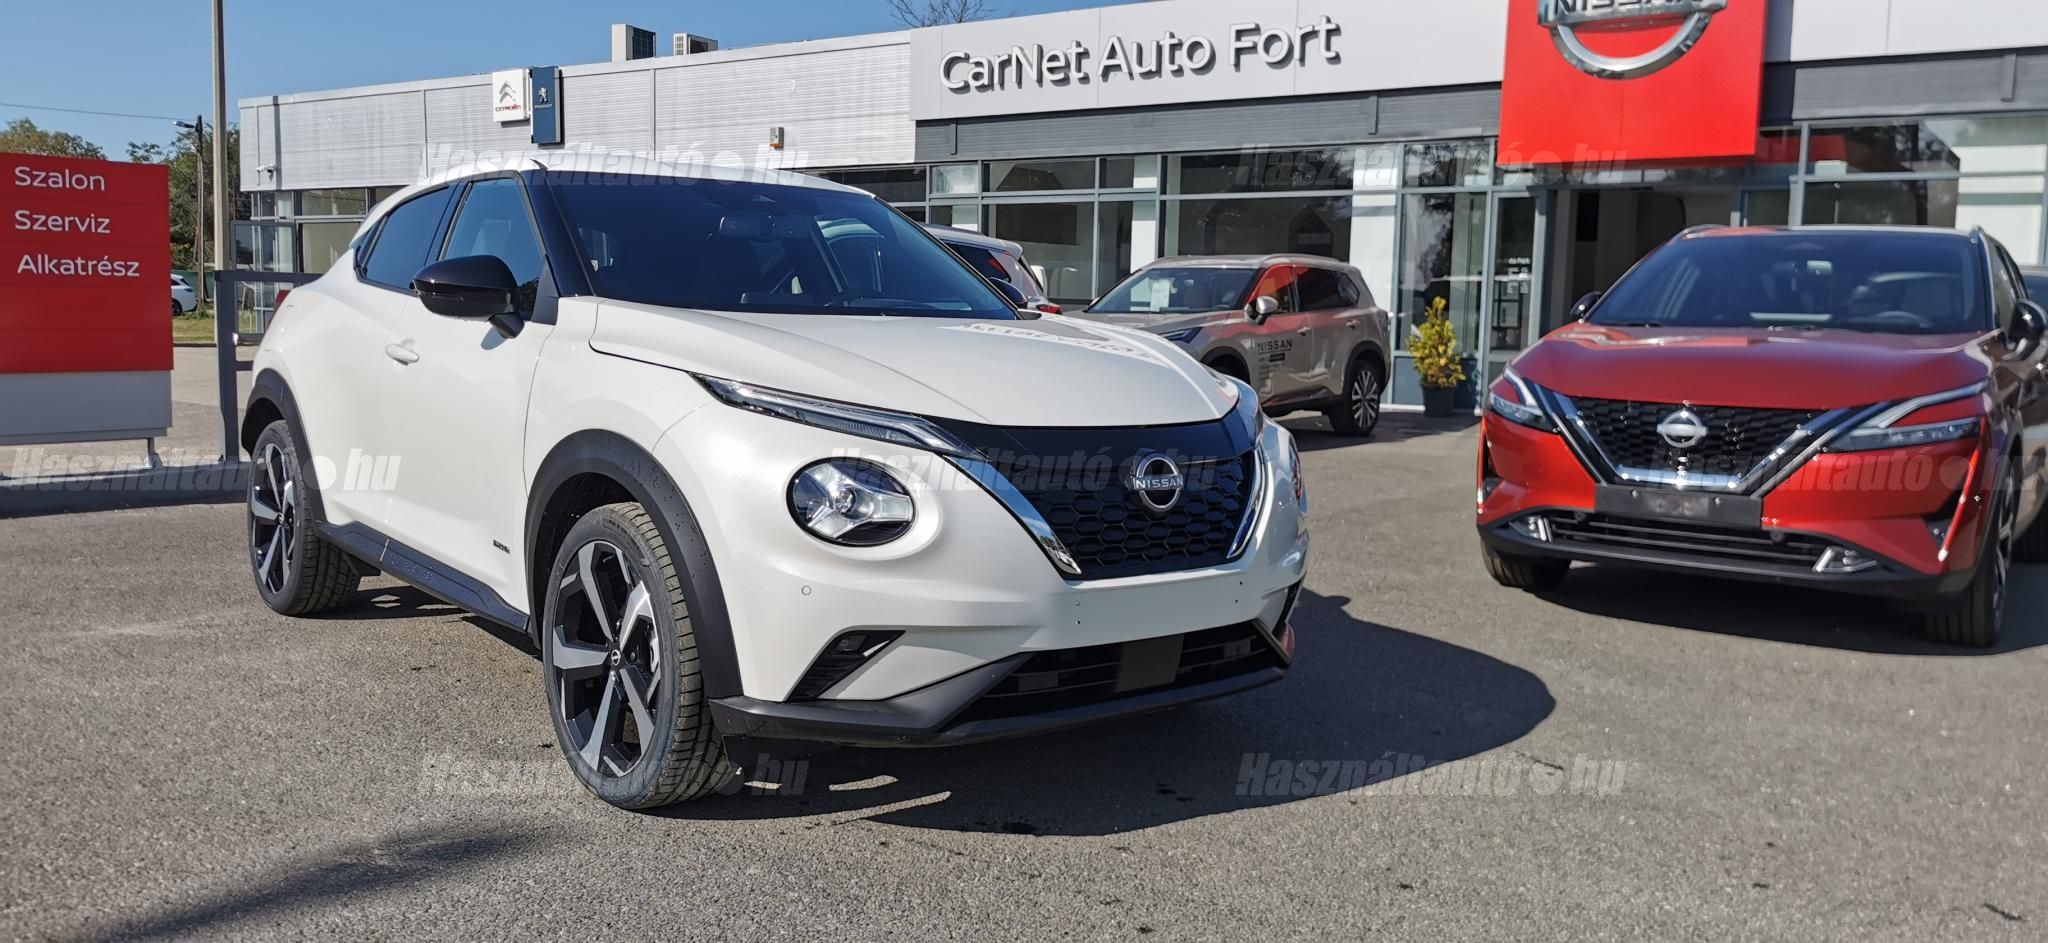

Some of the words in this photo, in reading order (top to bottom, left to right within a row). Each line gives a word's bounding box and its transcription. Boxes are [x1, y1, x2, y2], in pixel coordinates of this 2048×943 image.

[940, 39, 1089, 93] CarNet
[1098, 31, 1216, 82] Auto
[1229, 15, 1342, 71] Fort
[14, 166, 105, 191] Szalon
[14, 209, 111, 234] Szerviz
[16, 254, 140, 277] Alkatrész
[1257, 339, 1293, 352] NISSAN
[1135, 477, 1183, 489] NISSAN
